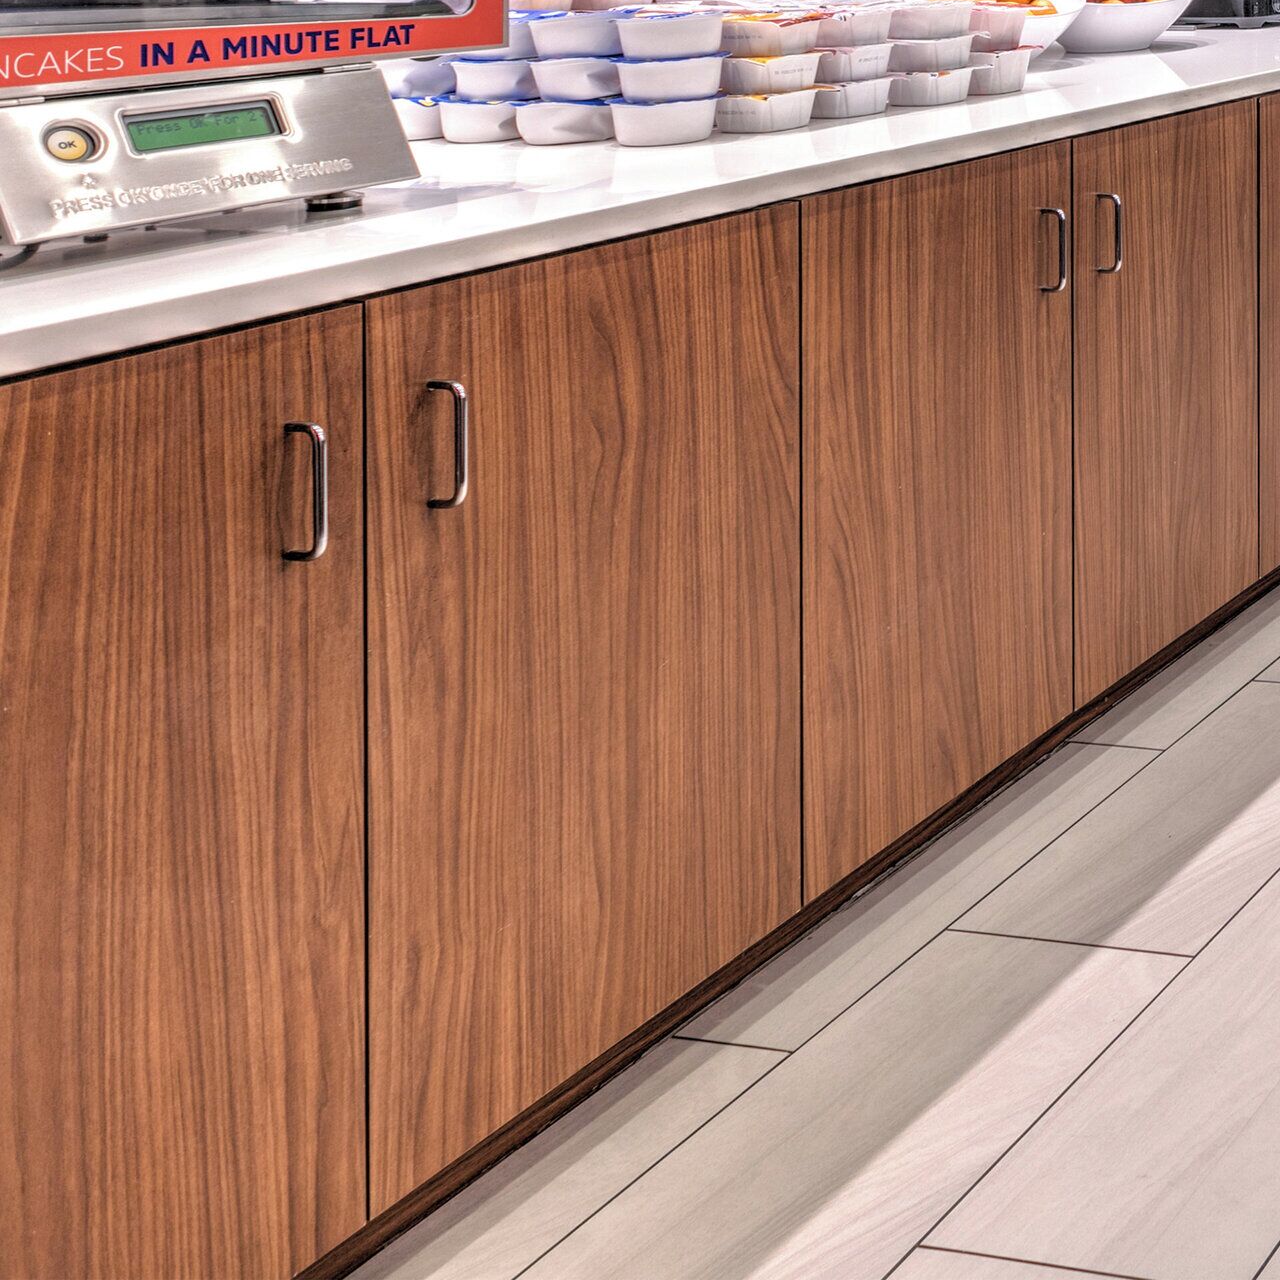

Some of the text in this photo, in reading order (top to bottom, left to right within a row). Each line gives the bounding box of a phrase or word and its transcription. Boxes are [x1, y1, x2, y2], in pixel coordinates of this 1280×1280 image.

[140, 42, 175, 67] IN
[187, 40, 211, 64] A
[222, 29, 340, 60] MINUTE
[350, 24, 415, 50] FLAT
[136, 123, 182, 136] Press
[58, 139, 78, 150] OK
[48, 193, 114, 219] PRESS
[208, 174, 246, 194] FOR
[246, 166, 285, 186] ONE
[285, 157, 354, 181] SERVING
